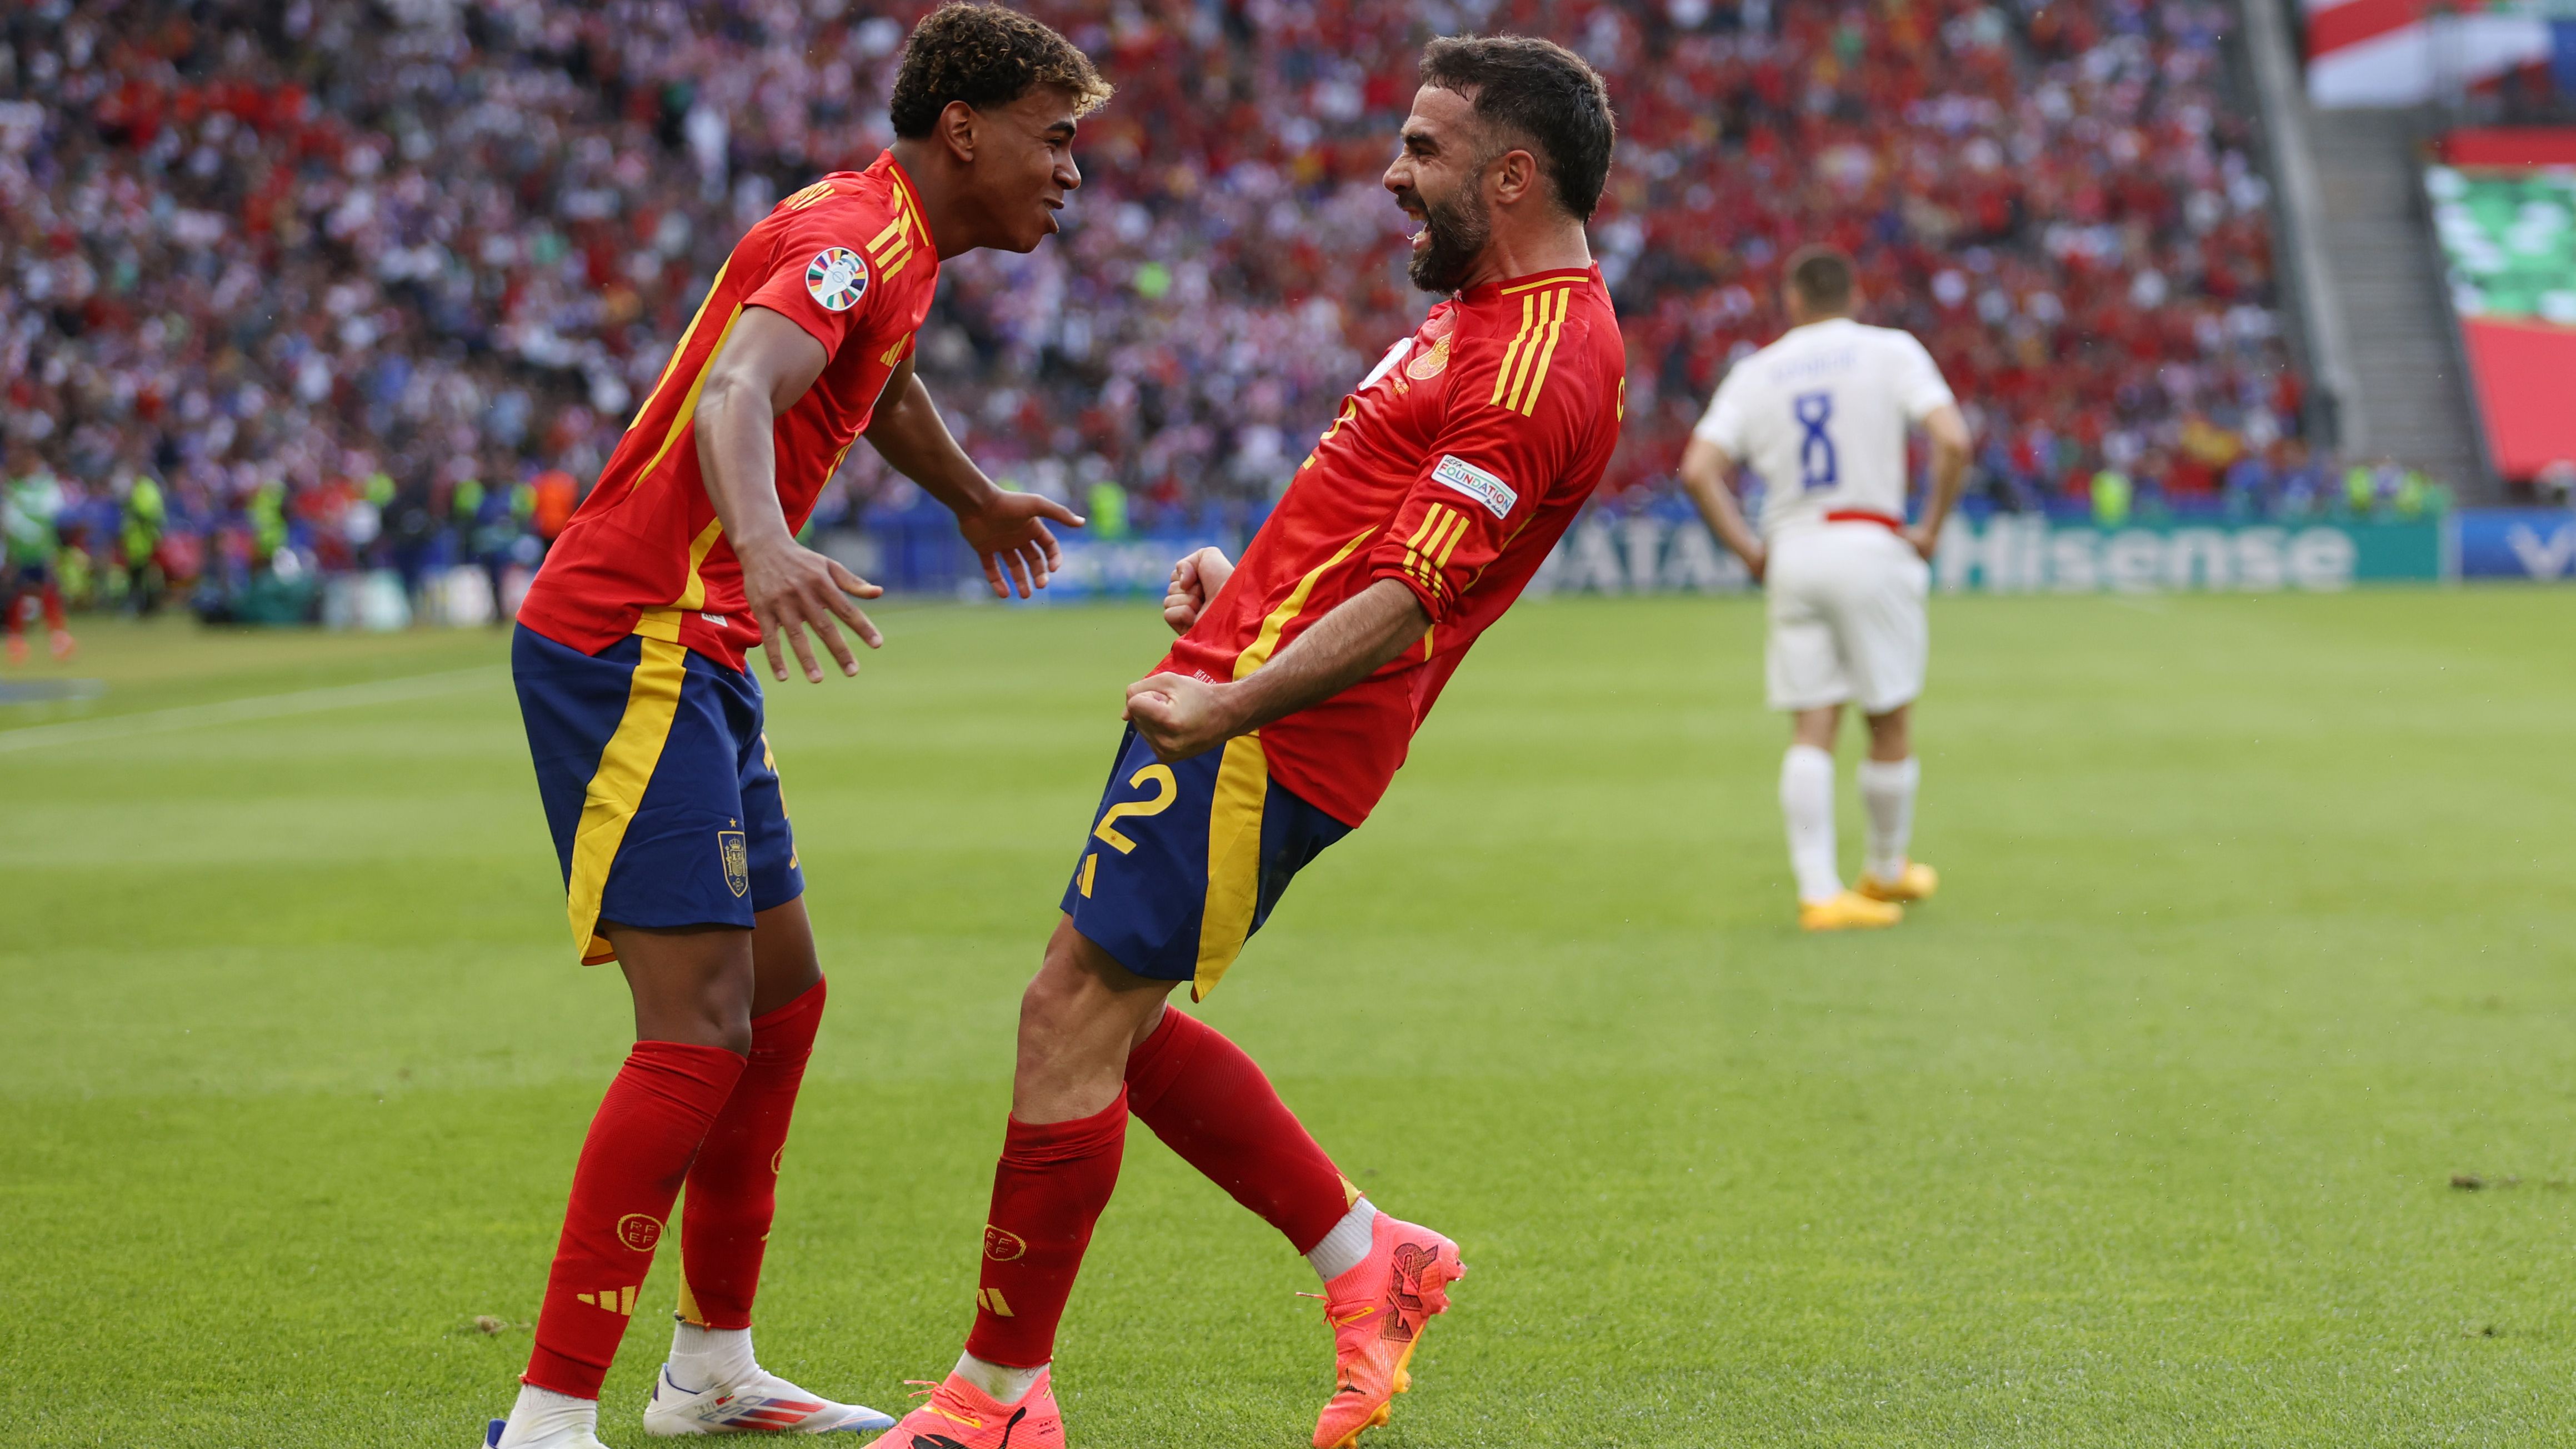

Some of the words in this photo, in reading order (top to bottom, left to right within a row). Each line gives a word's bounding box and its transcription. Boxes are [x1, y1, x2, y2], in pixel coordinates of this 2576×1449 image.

[1444, 457, 1462, 468] UEFA
[1794, 393, 1838, 490] 8
[1438, 463, 1512, 511] FOUNDATION
[1528, 517, 1761, 596] ATA
[1934, 512, 2358, 593] Hisense
[1093, 763, 1177, 855] 2
